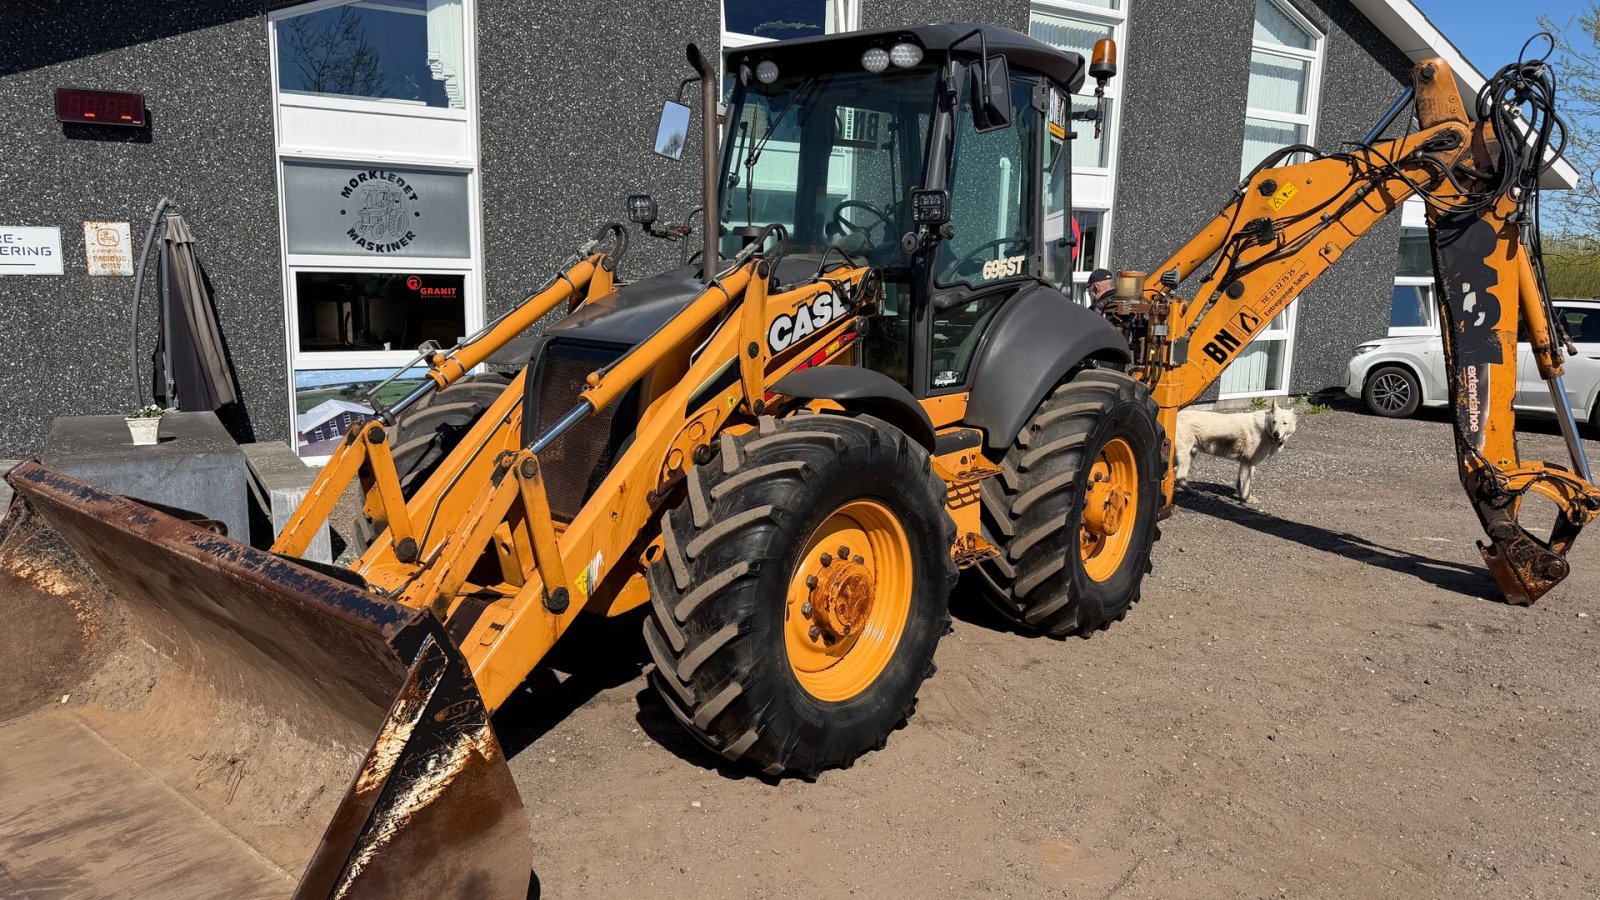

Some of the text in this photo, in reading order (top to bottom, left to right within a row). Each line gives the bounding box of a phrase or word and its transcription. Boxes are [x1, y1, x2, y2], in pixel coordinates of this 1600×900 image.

[0, 246, 52, 256] ERING
[347, 228, 416, 252] MASKINER
[983, 255, 1025, 280] 695ST
[1275, 281, 1283, 290] 22
[1282, 275, 1290, 283] 75
[1288, 268, 1296, 277] 25
[420, 287, 457, 295] GRANIT
[1202, 328, 1241, 365] BN
[1467, 365, 1480, 433] extendahoe
